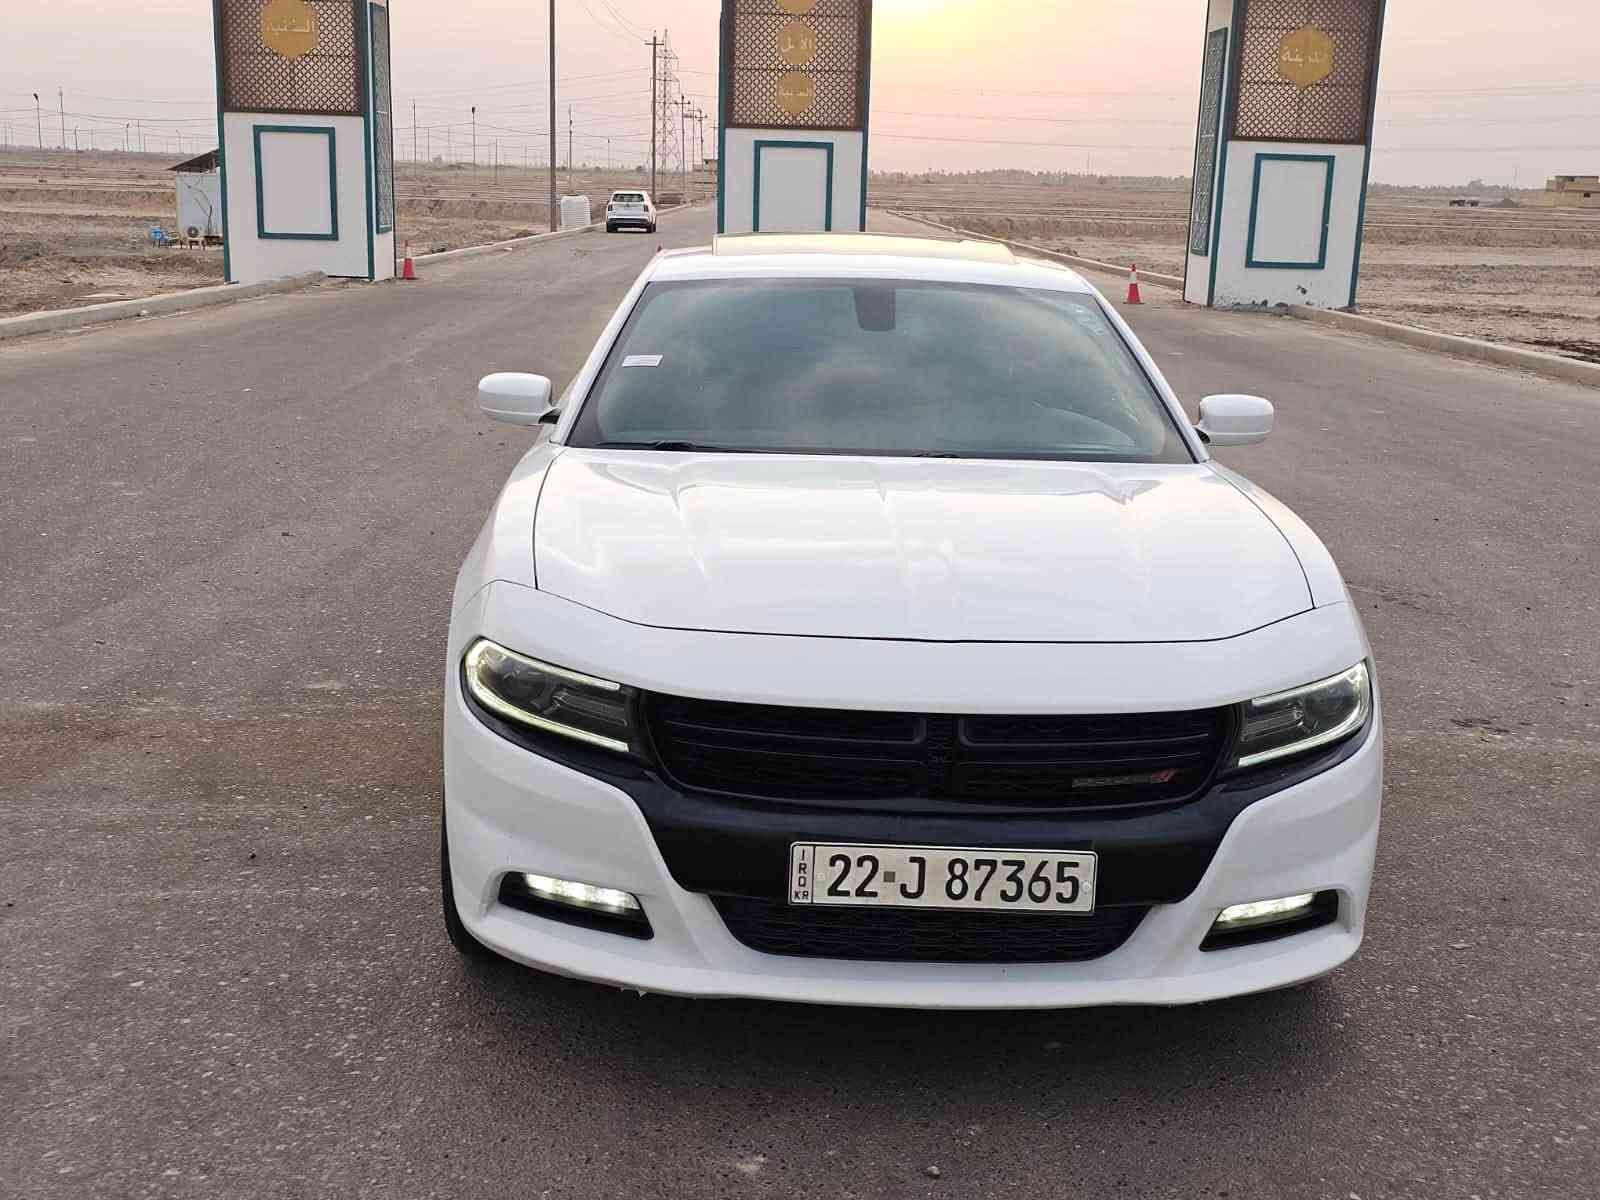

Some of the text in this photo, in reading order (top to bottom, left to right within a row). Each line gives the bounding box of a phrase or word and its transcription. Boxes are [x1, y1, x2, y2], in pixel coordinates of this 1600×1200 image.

[827, 853, 1081, 904] 22 J 87365
[794, 889, 810, 900] KR
